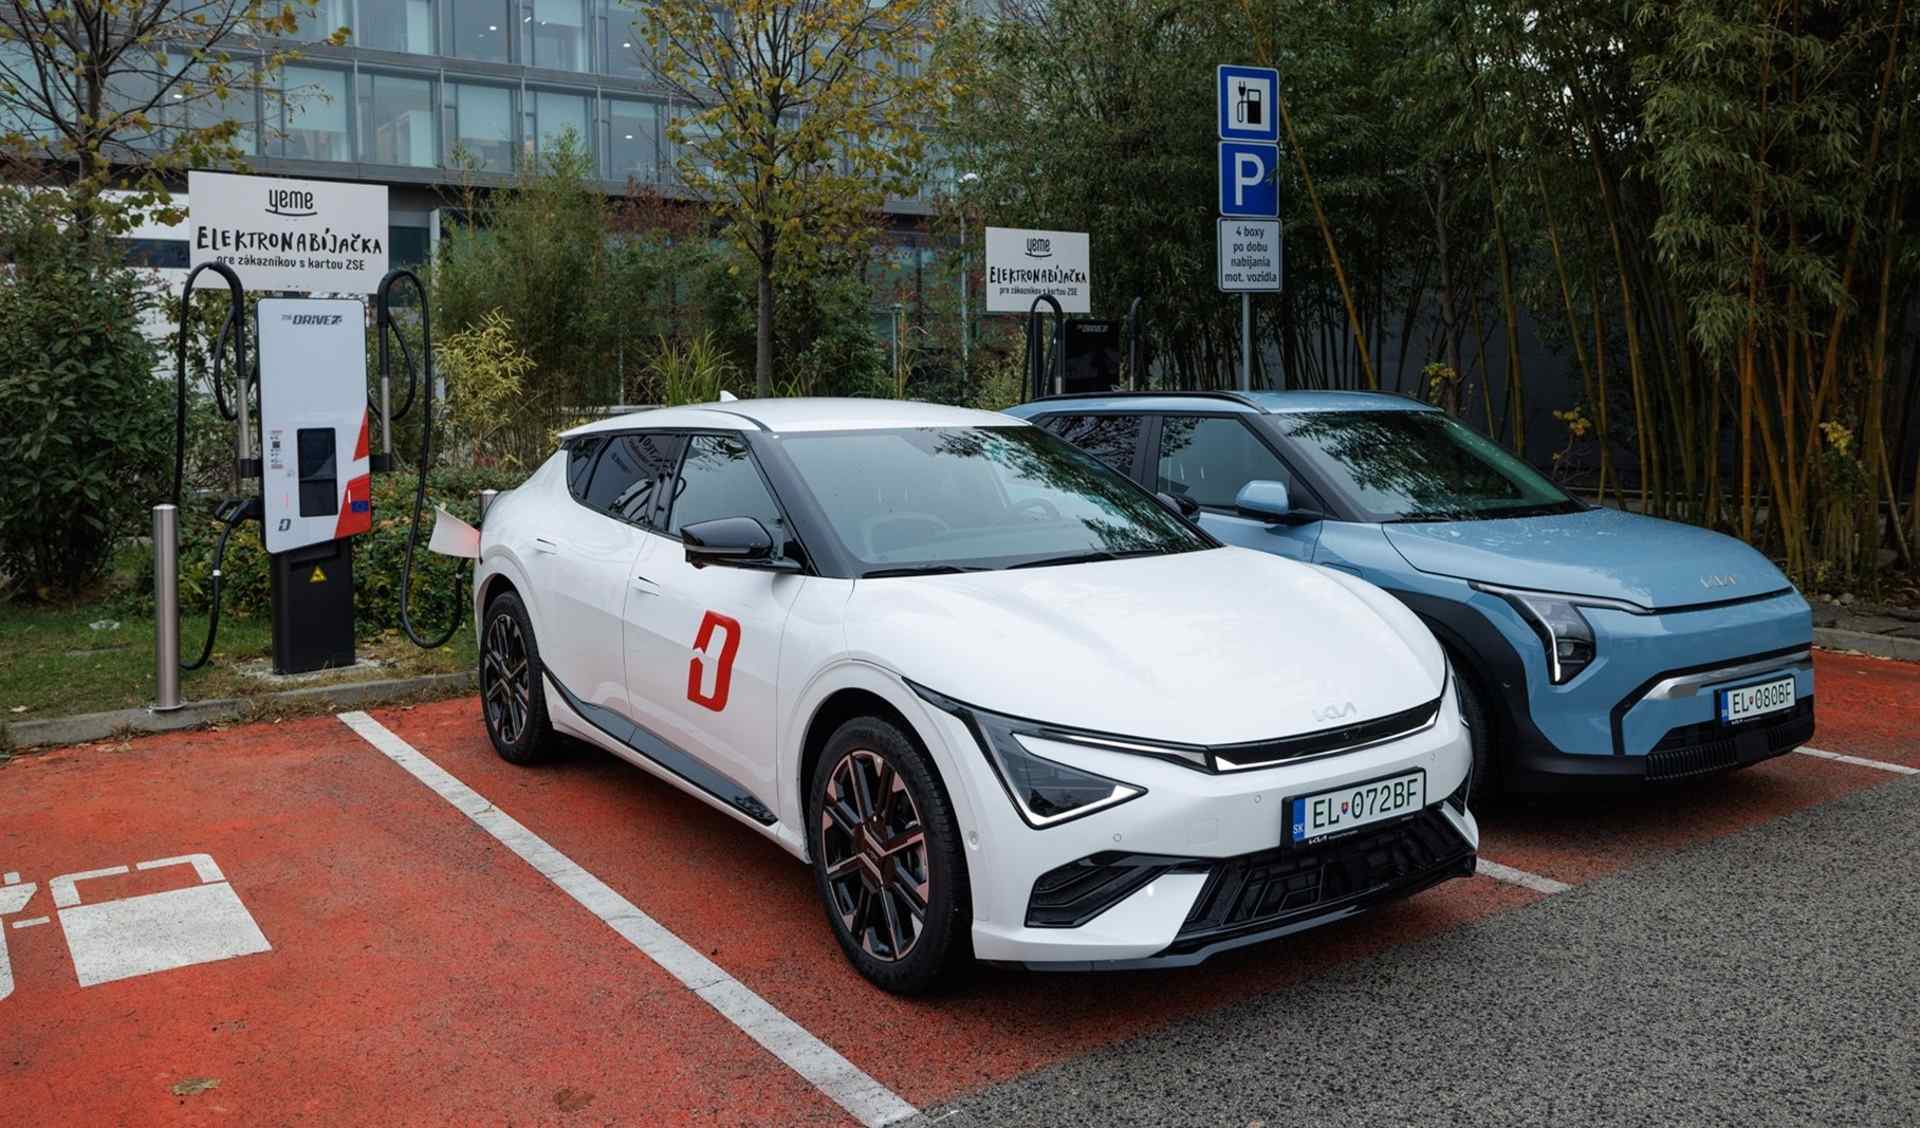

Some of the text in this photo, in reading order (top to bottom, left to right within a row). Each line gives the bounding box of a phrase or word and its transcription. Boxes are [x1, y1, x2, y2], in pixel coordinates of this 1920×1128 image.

[1235, 152, 1265, 206] P
[269, 189, 314, 213] yeme
[197, 226, 382, 254] ELEKTRONABÍJAČKA
[1235, 225, 1265, 239] 4 boxy
[1026, 238, 1050, 255] yeme
[1233, 240, 1268, 254] po dobu
[299, 259, 305, 269] s
[308, 256, 344, 270] kartou
[345, 258, 365, 271] ZSE
[1224, 271, 1277, 282] mot. vozidla
[1732, 692, 1750, 714] EL
[1313, 778, 1418, 829] EL 072BF
[1293, 824, 1304, 835] SK
